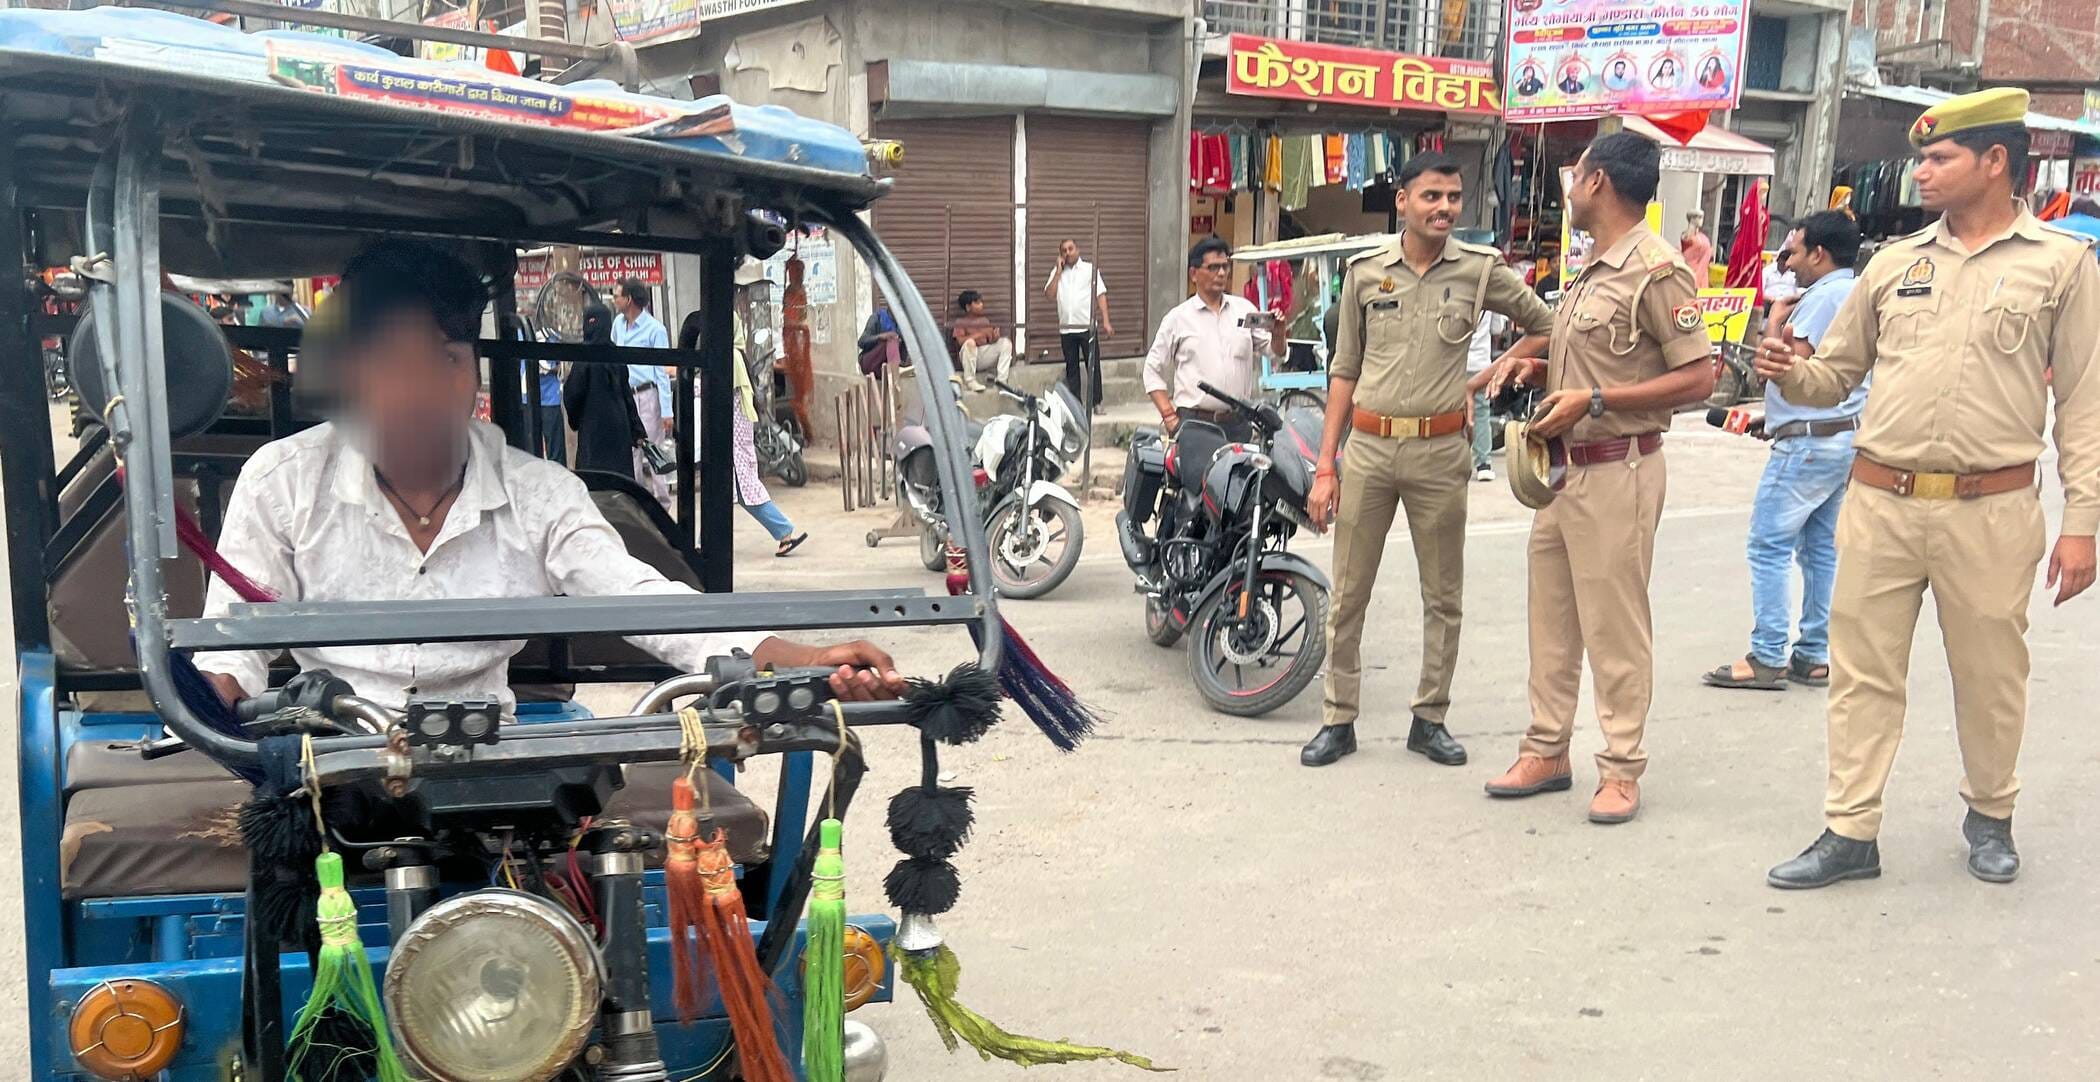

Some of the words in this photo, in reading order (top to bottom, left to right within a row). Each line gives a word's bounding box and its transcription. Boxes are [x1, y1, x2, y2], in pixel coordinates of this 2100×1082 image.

[1691, 6, 1709, 17] 56
[1233, 42, 1381, 99] फैशन
[1392, 58, 1502, 111] विहार
[353, 70, 379, 84] कार्य
[382, 75, 415, 90] कुशल
[491, 87, 518, 105] किया
[520, 96, 546, 109] जाता
[580, 257, 604, 271] ASTE
[607, 256, 621, 269] OF
[624, 254, 656, 269] CHINA
[591, 271, 610, 281] UNIT
[612, 271, 623, 280] OF
[625, 269, 649, 281] DELHI
